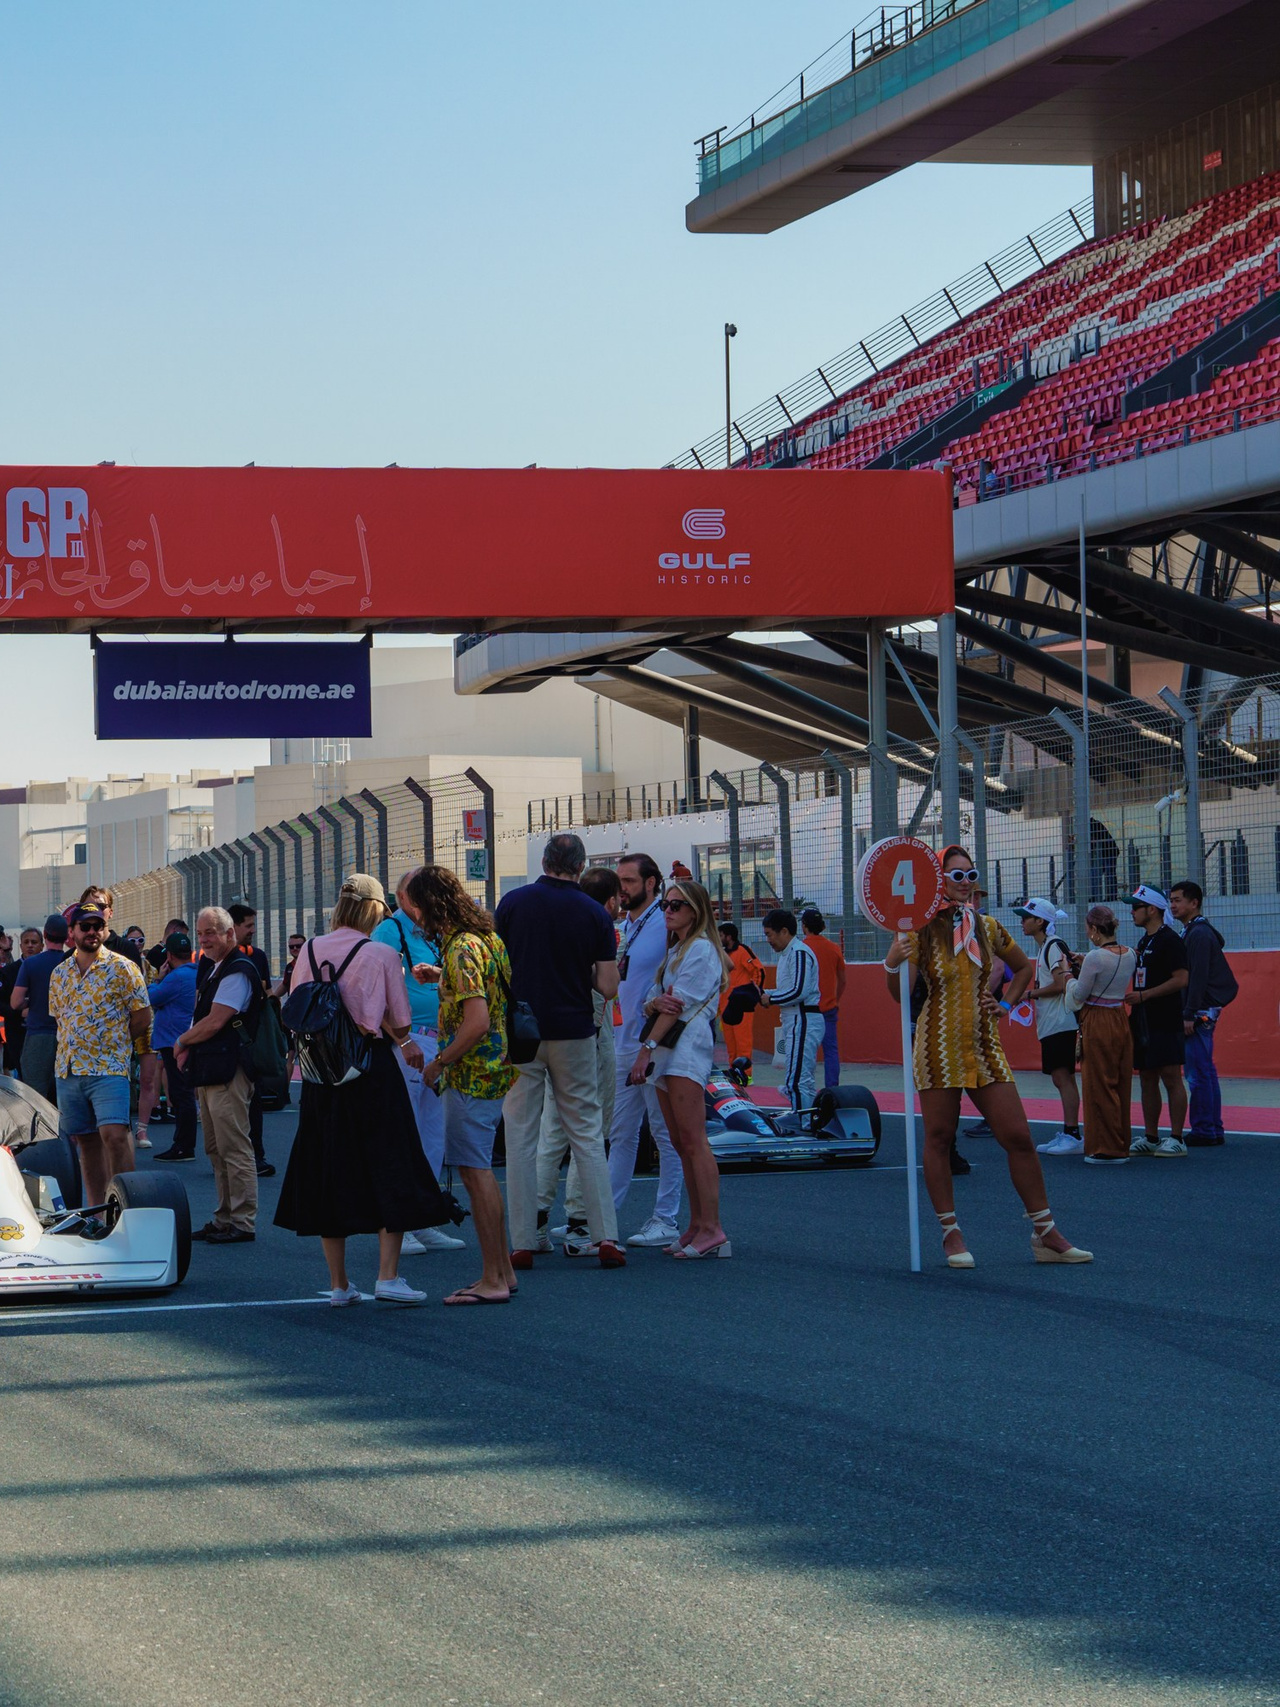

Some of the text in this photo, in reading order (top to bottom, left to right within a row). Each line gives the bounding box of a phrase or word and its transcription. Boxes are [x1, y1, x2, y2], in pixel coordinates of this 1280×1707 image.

[5, 487, 89, 558] GP
[89, 513, 246, 615] سباق
[249, 504, 373, 615] إحياء
[658, 553, 751, 570] GULF
[658, 575, 751, 584] HISTORIC
[113, 680, 356, 701] dubaiautodrome.ae
[881, 837, 911, 852] DUBAI
[911, 839, 926, 852] GP
[863, 850, 882, 898] HISTORIC
[923, 848, 944, 890] REVIVAL
[891, 860, 917, 905] 4
[866, 900, 886, 923] GULF
[924, 893, 941, 919] 2023
